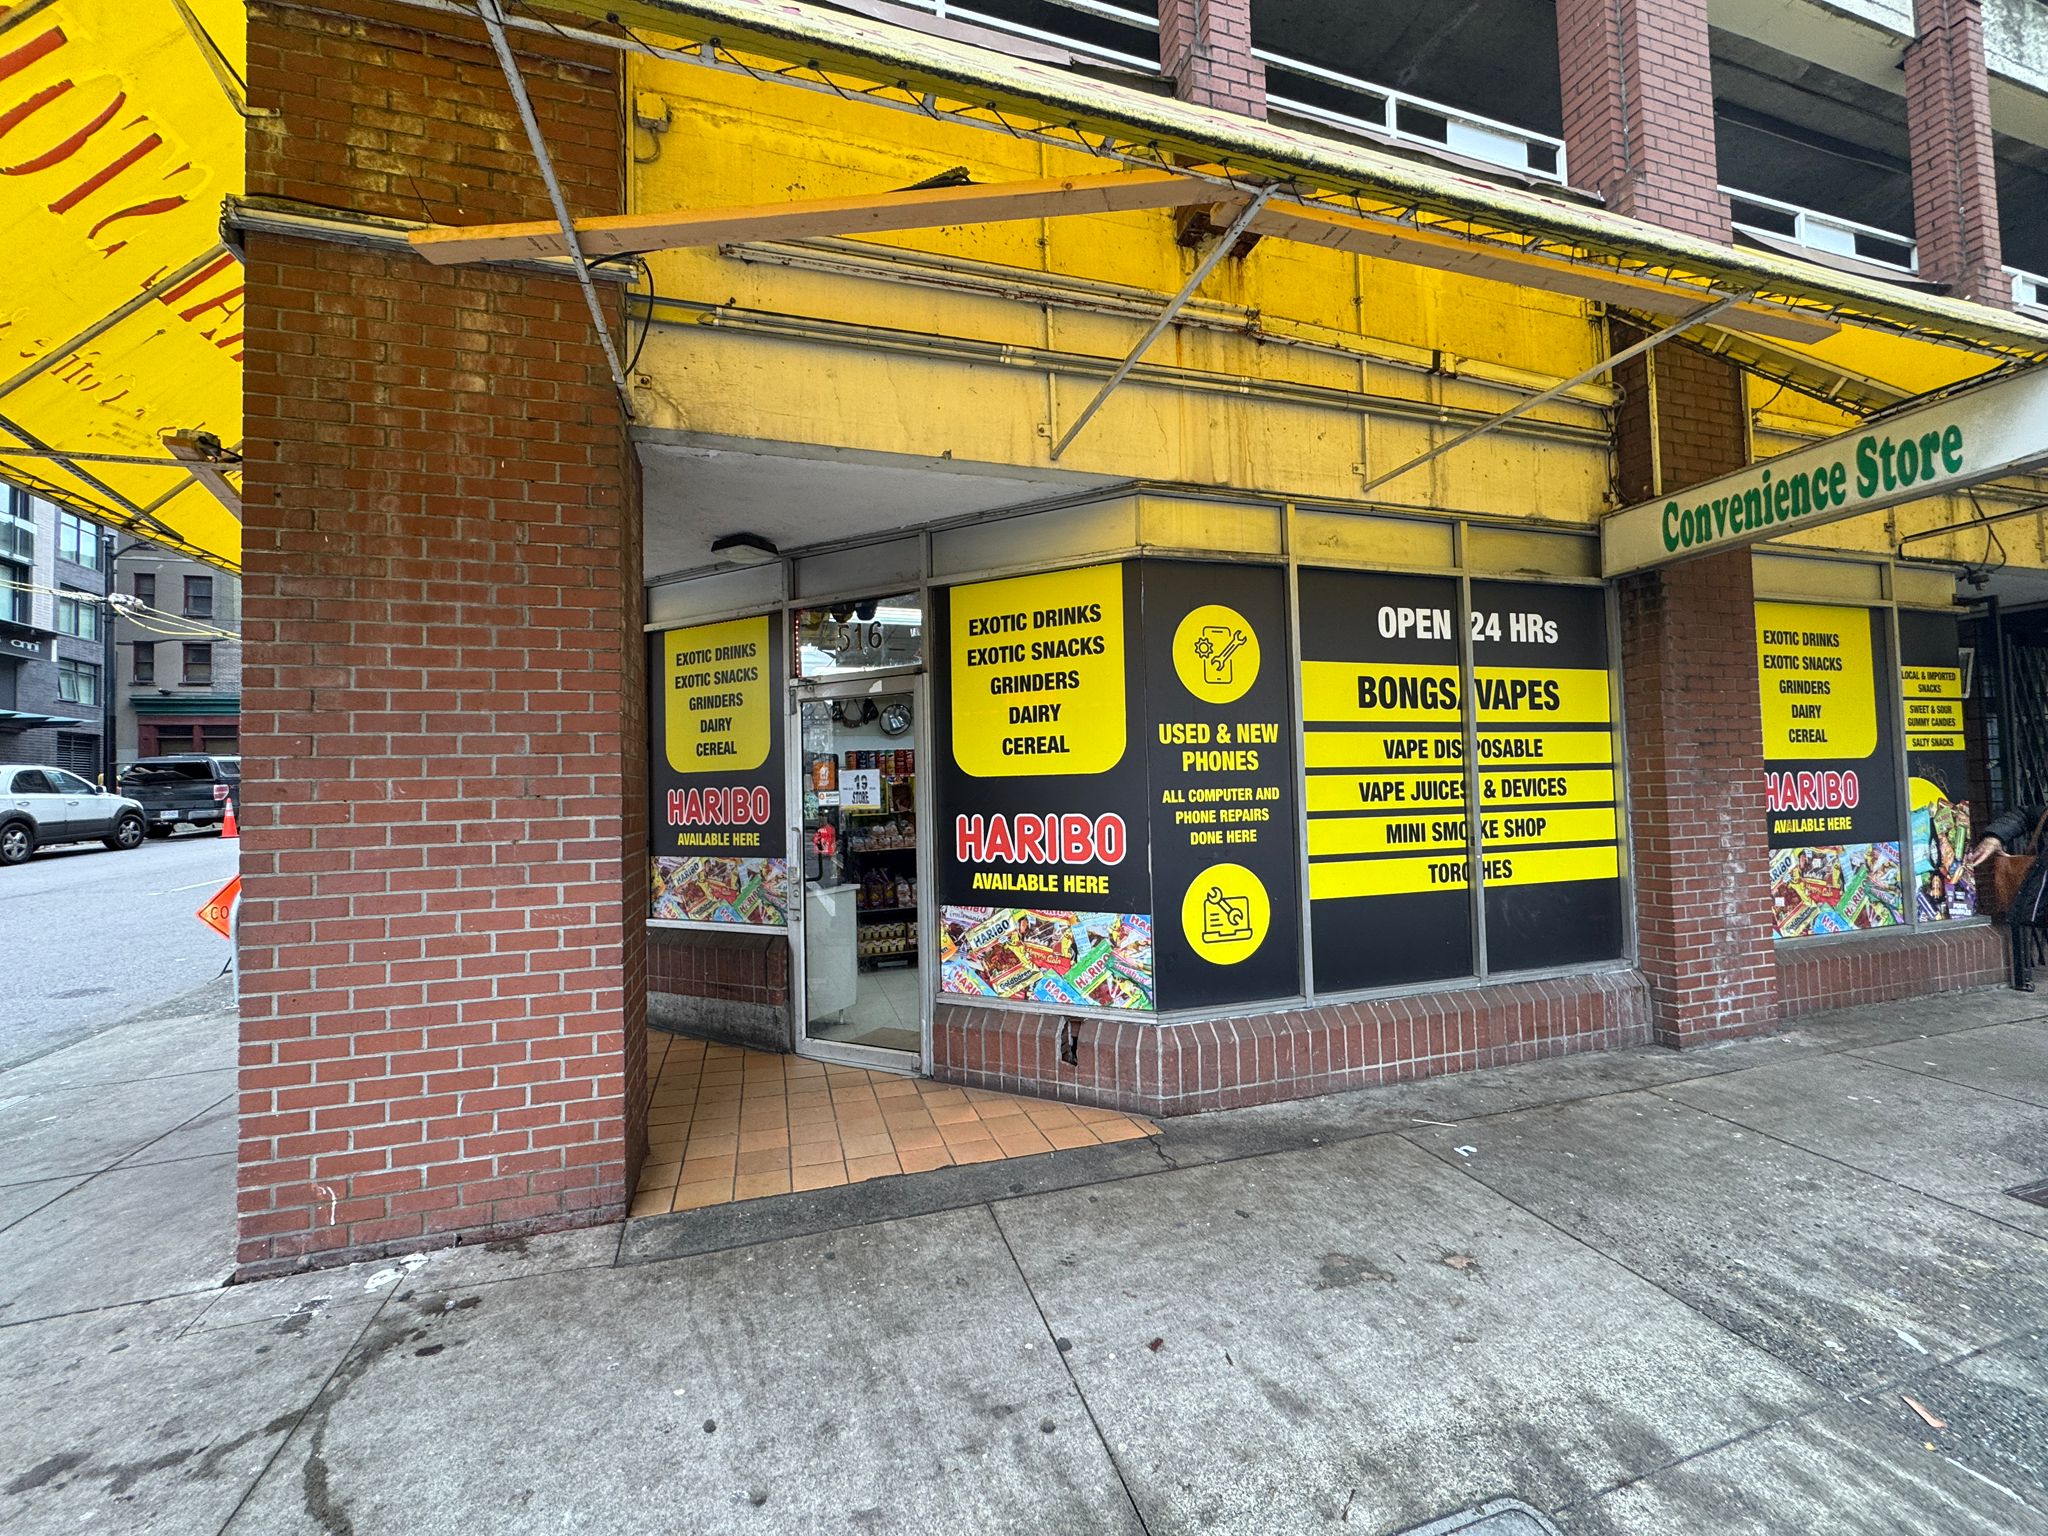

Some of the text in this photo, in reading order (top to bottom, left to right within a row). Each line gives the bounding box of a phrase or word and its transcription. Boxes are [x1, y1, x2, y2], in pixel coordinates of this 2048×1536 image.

[1661, 424, 1964, 553] Convenience Store
[968, 604, 1102, 637] EXOTIC DRINKS
[1377, 606, 1559, 645] OPEN 24 HRs
[837, 621, 883, 652] 516
[1763, 630, 1840, 647] EXOTIC DRINKS
[676, 643, 757, 667] EXOTIC DRINKS
[967, 635, 1105, 667] EXOTIC SNACKS
[1763, 655, 1842, 671] EXOTIC SNACKS
[675, 667, 758, 690] EXOTIC SNACKS
[990, 670, 1080, 695] GRINDERS
[1901, 670, 1956, 681] LOCAL & IMPORTED
[1474, 679, 1560, 711] VAPES
[1779, 680, 1831, 695] GRINDERS
[1918, 684, 1941, 693] SNACKS
[689, 692, 744, 711] GRINDERS
[1791, 704, 1821, 719] DAIRY
[1909, 705, 1952, 714] SWEET & SOUR
[1009, 704, 1061, 725] DAIRY
[1908, 717, 1956, 727] GUMMY CANDIES
[700, 717, 733, 733] DAIRY
[1159, 724, 1279, 744] USED & NEW
[1002, 735, 1070, 756] CEREAL
[1788, 728, 1828, 743] CEREAL
[1912, 738, 1954, 747] SALTY SNACKS
[696, 741, 737, 757] CEREAL
[1384, 739, 1543, 759] VAPE DISOSABLE
[1182, 750, 1259, 772] PHONES
[854, 774, 868, 790] 19
[1358, 781, 1405, 803] VAPE
[1483, 779, 1497, 799] &
[1501, 777, 1567, 799] DEVICES
[1764, 770, 1859, 812] HARIBO
[852, 791, 870, 804] STORE
[1162, 786, 1280, 804] ALL COMPUTER AND
[666, 785, 771, 826] HARIBO
[1175, 808, 1269, 825] PHONE REPAIRS
[1774, 816, 1852, 834] AVAILABLE HERE
[677, 832, 760, 847] AVAILABLE HERE
[955, 812, 1126, 866] HARIBO
[1190, 829, 1257, 846] DONE HERE
[1386, 823, 1426, 844] MINI
[1504, 817, 1547, 838] SHOP
[675, 863, 700, 884] HARIBO
[1771, 857, 1792, 882] RIBO
[972, 872, 1109, 894] AVAILABLE HERE
[973, 919, 1010, 948] HARIBO
